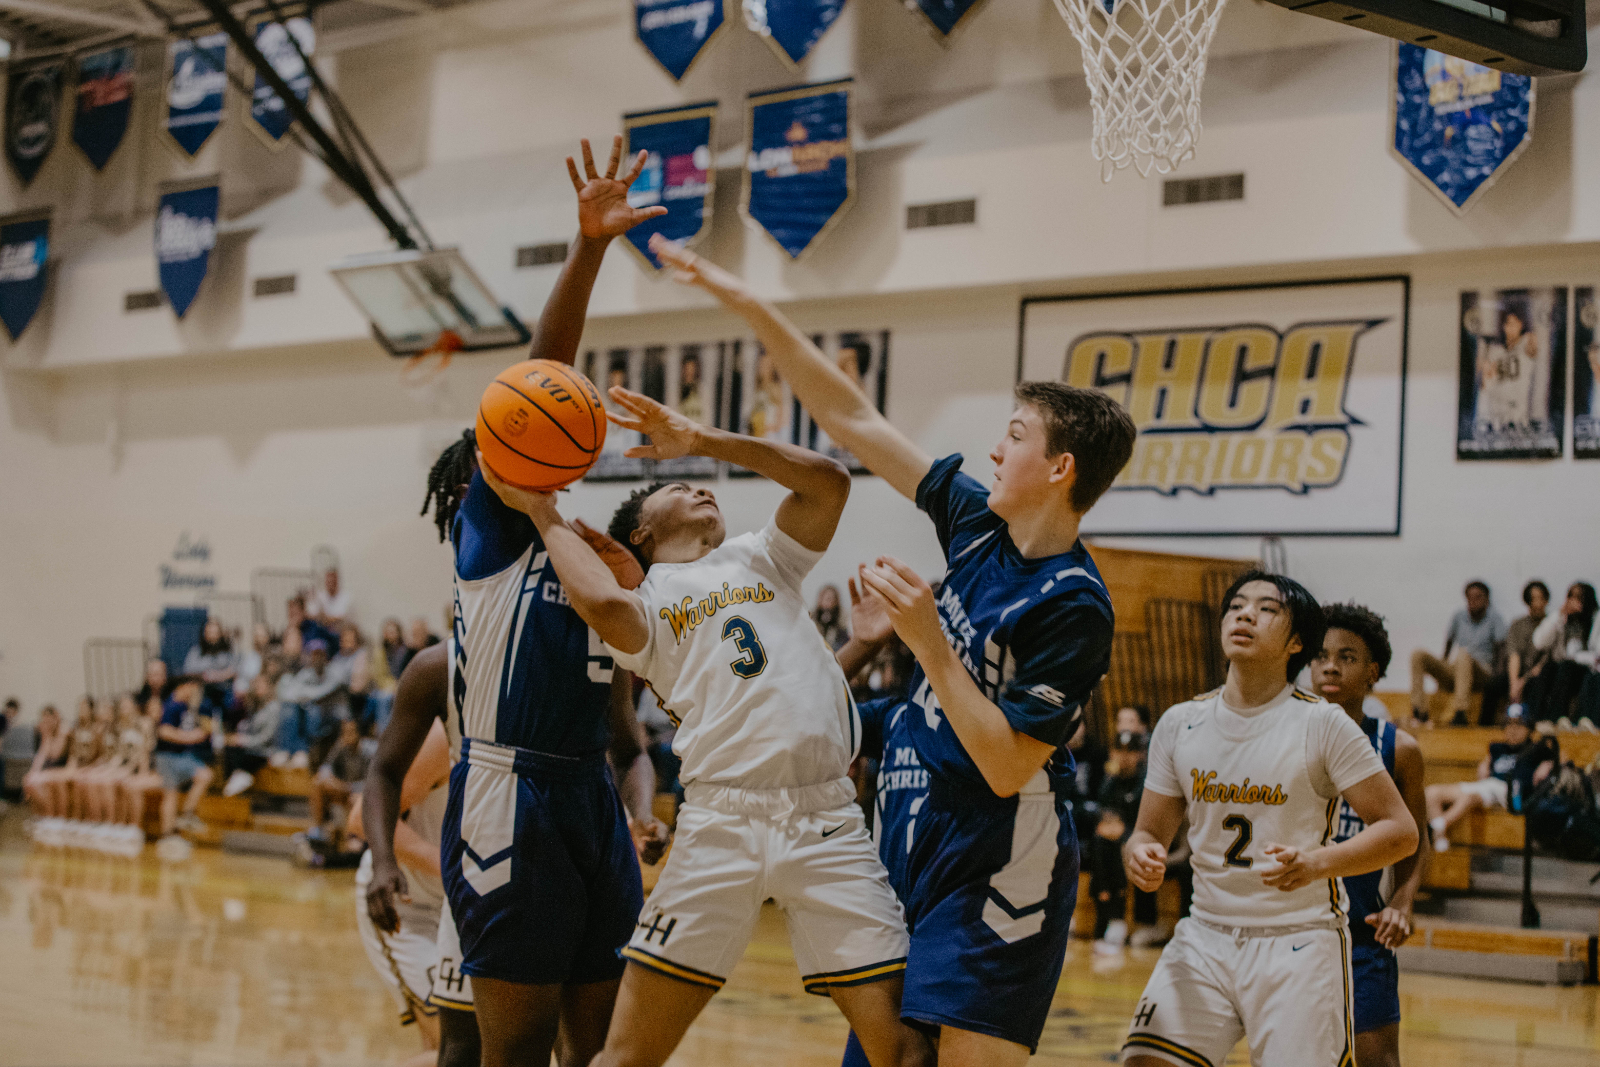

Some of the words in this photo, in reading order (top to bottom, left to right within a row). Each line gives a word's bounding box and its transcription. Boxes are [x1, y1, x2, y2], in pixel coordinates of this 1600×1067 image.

[1061, 318, 1383, 434] CHCA
[659, 582, 775, 646] Warriors
[721, 615, 769, 680] 3
[1191, 768, 1288, 805] Warriors
[1222, 814, 1253, 868] 2
